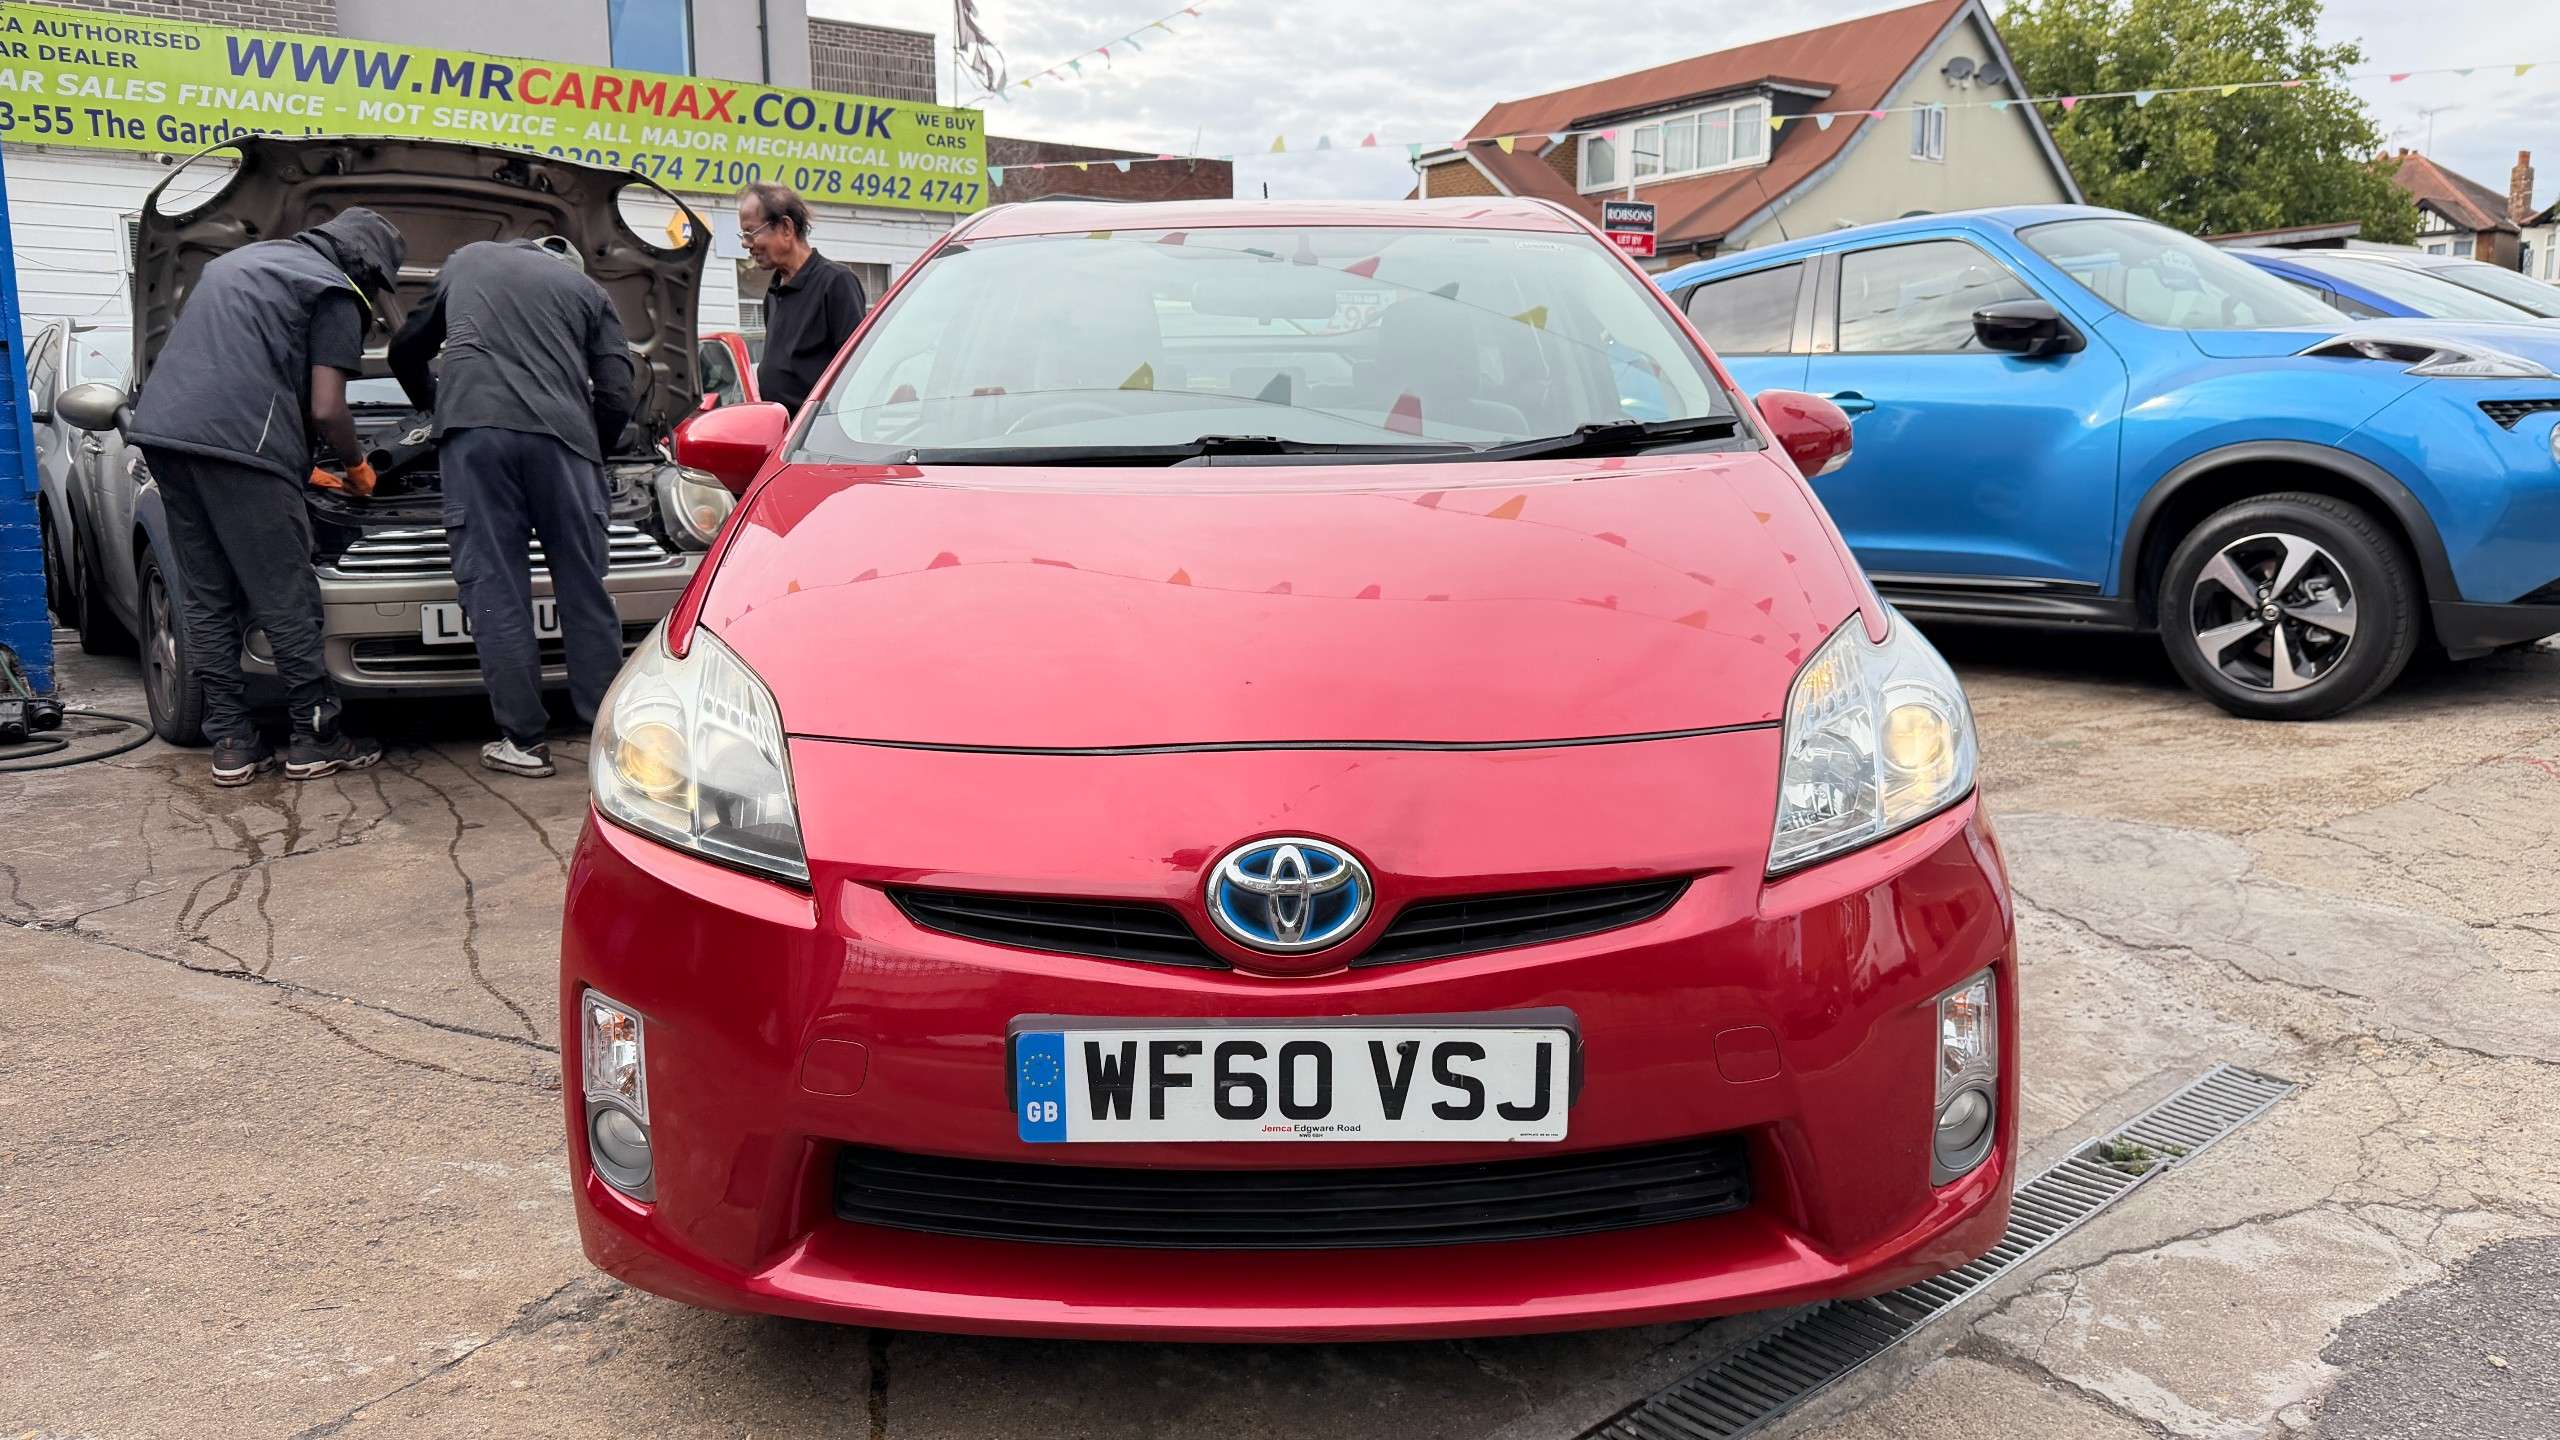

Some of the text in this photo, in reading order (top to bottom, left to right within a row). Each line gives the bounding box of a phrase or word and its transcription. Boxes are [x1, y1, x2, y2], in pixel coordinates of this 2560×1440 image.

[0, 15, 201, 51] A AUTHORISED
[38, 44, 139, 69] DEALER
[226, 35, 896, 140] WWW.MRCARMAX.CO.UK
[56, 73, 167, 103] SALES
[178, 84, 325, 116] FINANCE
[357, 100, 425, 126] MOT
[433, 107, 556, 137] SERVICE
[583, 121, 632, 144] ALL
[641, 126, 728, 152] MAJOR
[736, 136, 890, 167] MECHANICAL
[899, 152, 978, 176] WORKS
[84, 108, 146, 140] The
[156, 114, 284, 145] Garde
[916, 112, 976, 131] WE BUY
[926, 133, 967, 149] CARS
[631, 153, 683, 181] 674
[695, 158, 762, 186] 7100
[795, 167, 842, 193] 078
[851, 173, 912, 199] 4942
[920, 179, 980, 206] 4747
[1607, 208, 1653, 222] ROBSONS
[1616, 234, 1631, 245] LET
[1083, 1040, 1552, 1121] WF60 VSJ
[1026, 1101, 1058, 1123] GB
[1261, 1124, 1361, 1134] Jemca Edgware Road
